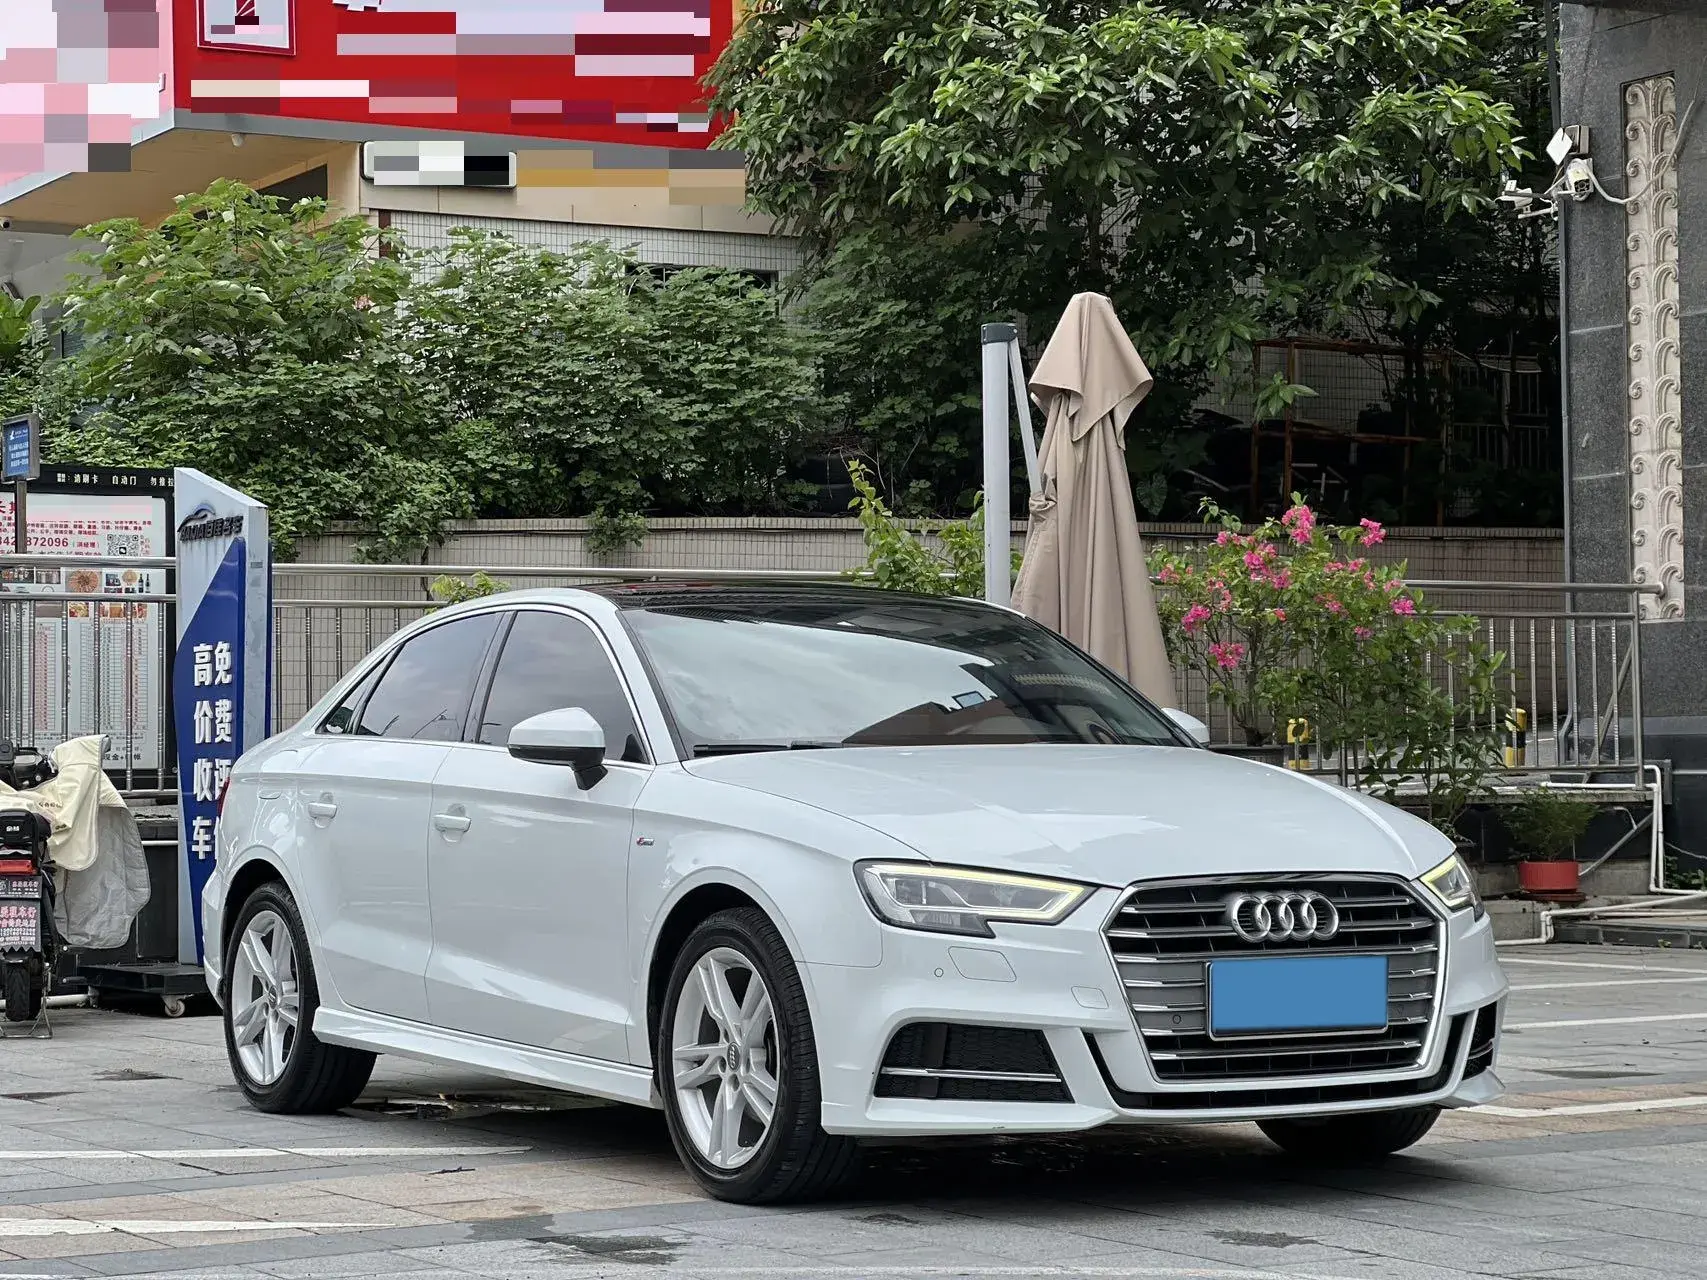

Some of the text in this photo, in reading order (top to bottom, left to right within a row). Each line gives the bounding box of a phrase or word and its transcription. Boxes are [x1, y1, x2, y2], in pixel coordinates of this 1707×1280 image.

[112, 475, 137, 485] 自动门
[192, 643, 213, 860] 高价收车
[214, 641, 232, 860] 免费评
